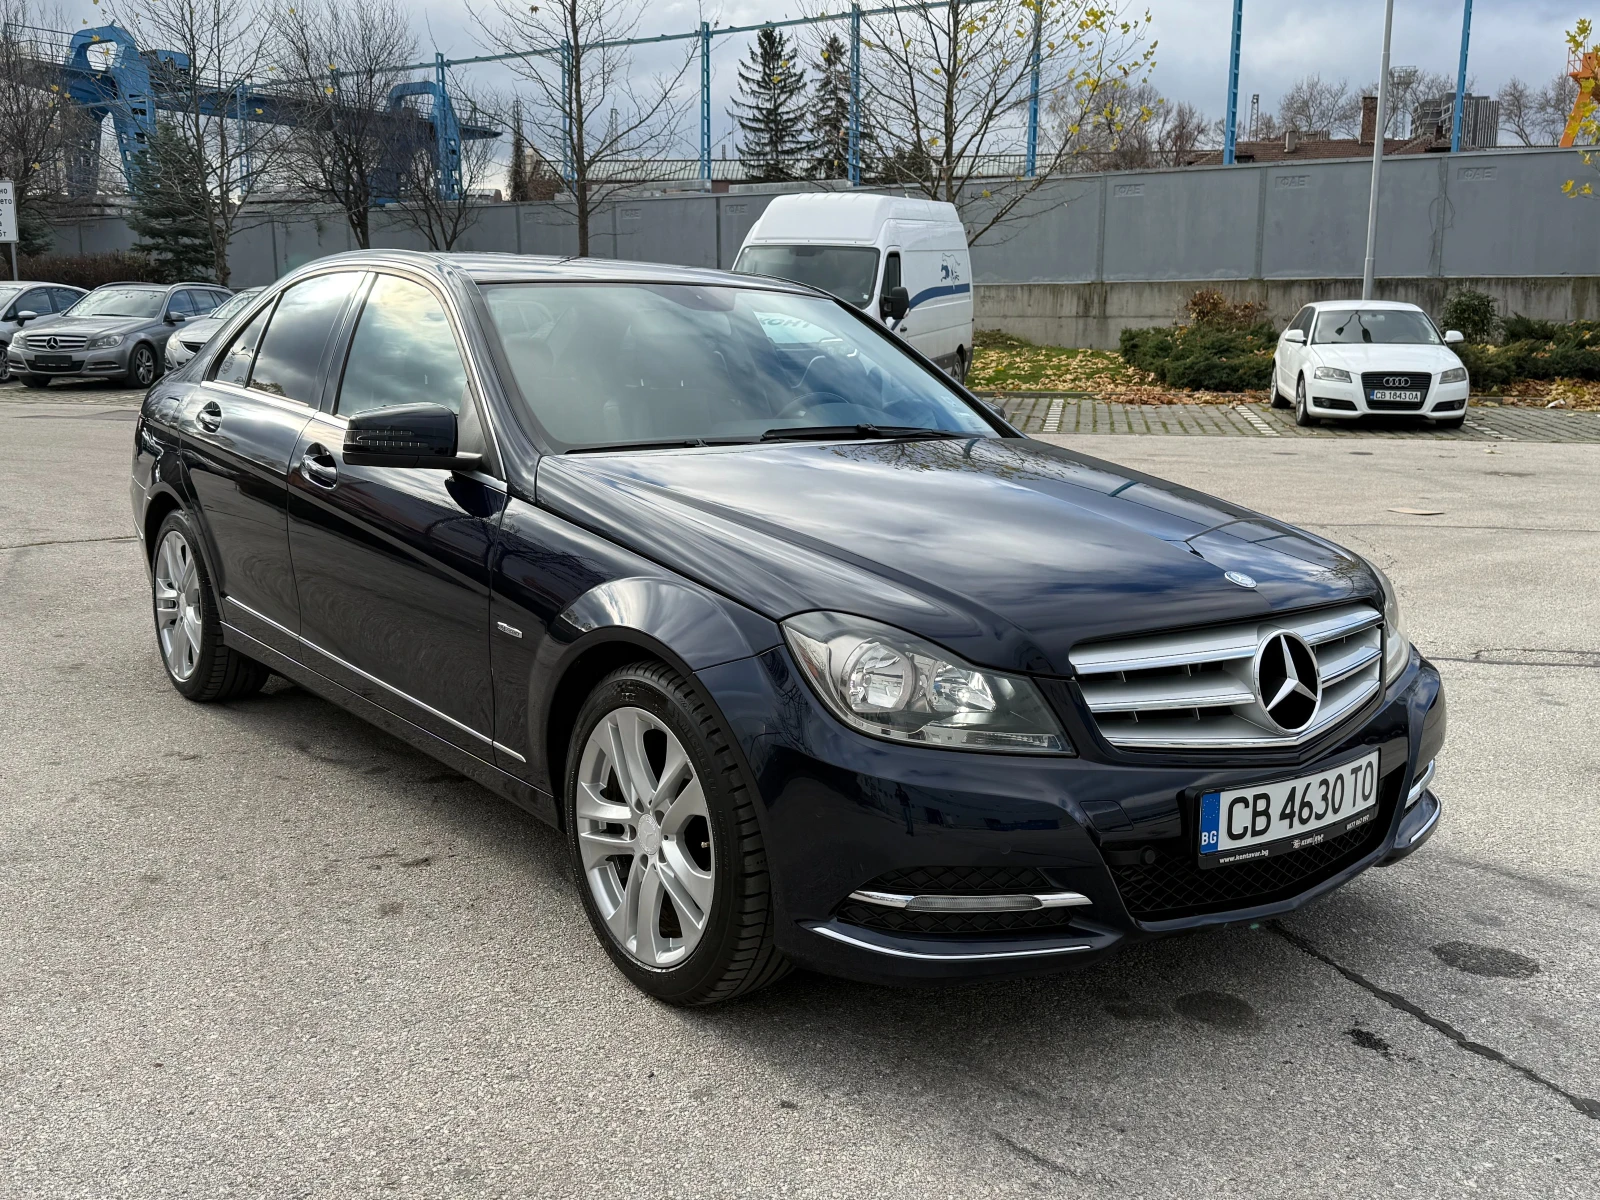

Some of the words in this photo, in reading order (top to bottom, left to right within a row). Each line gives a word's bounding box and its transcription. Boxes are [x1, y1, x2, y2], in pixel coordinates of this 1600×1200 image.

[1375, 391, 1386, 399] CB
[1389, 391, 1407, 400] 1843
[1226, 792, 1271, 841] CB
[1279, 772, 1345, 829] 4630
[1350, 760, 1374, 808] TO
[1201, 830, 1217, 846] BG
[1218, 849, 1269, 864] www.kentavar.bg
